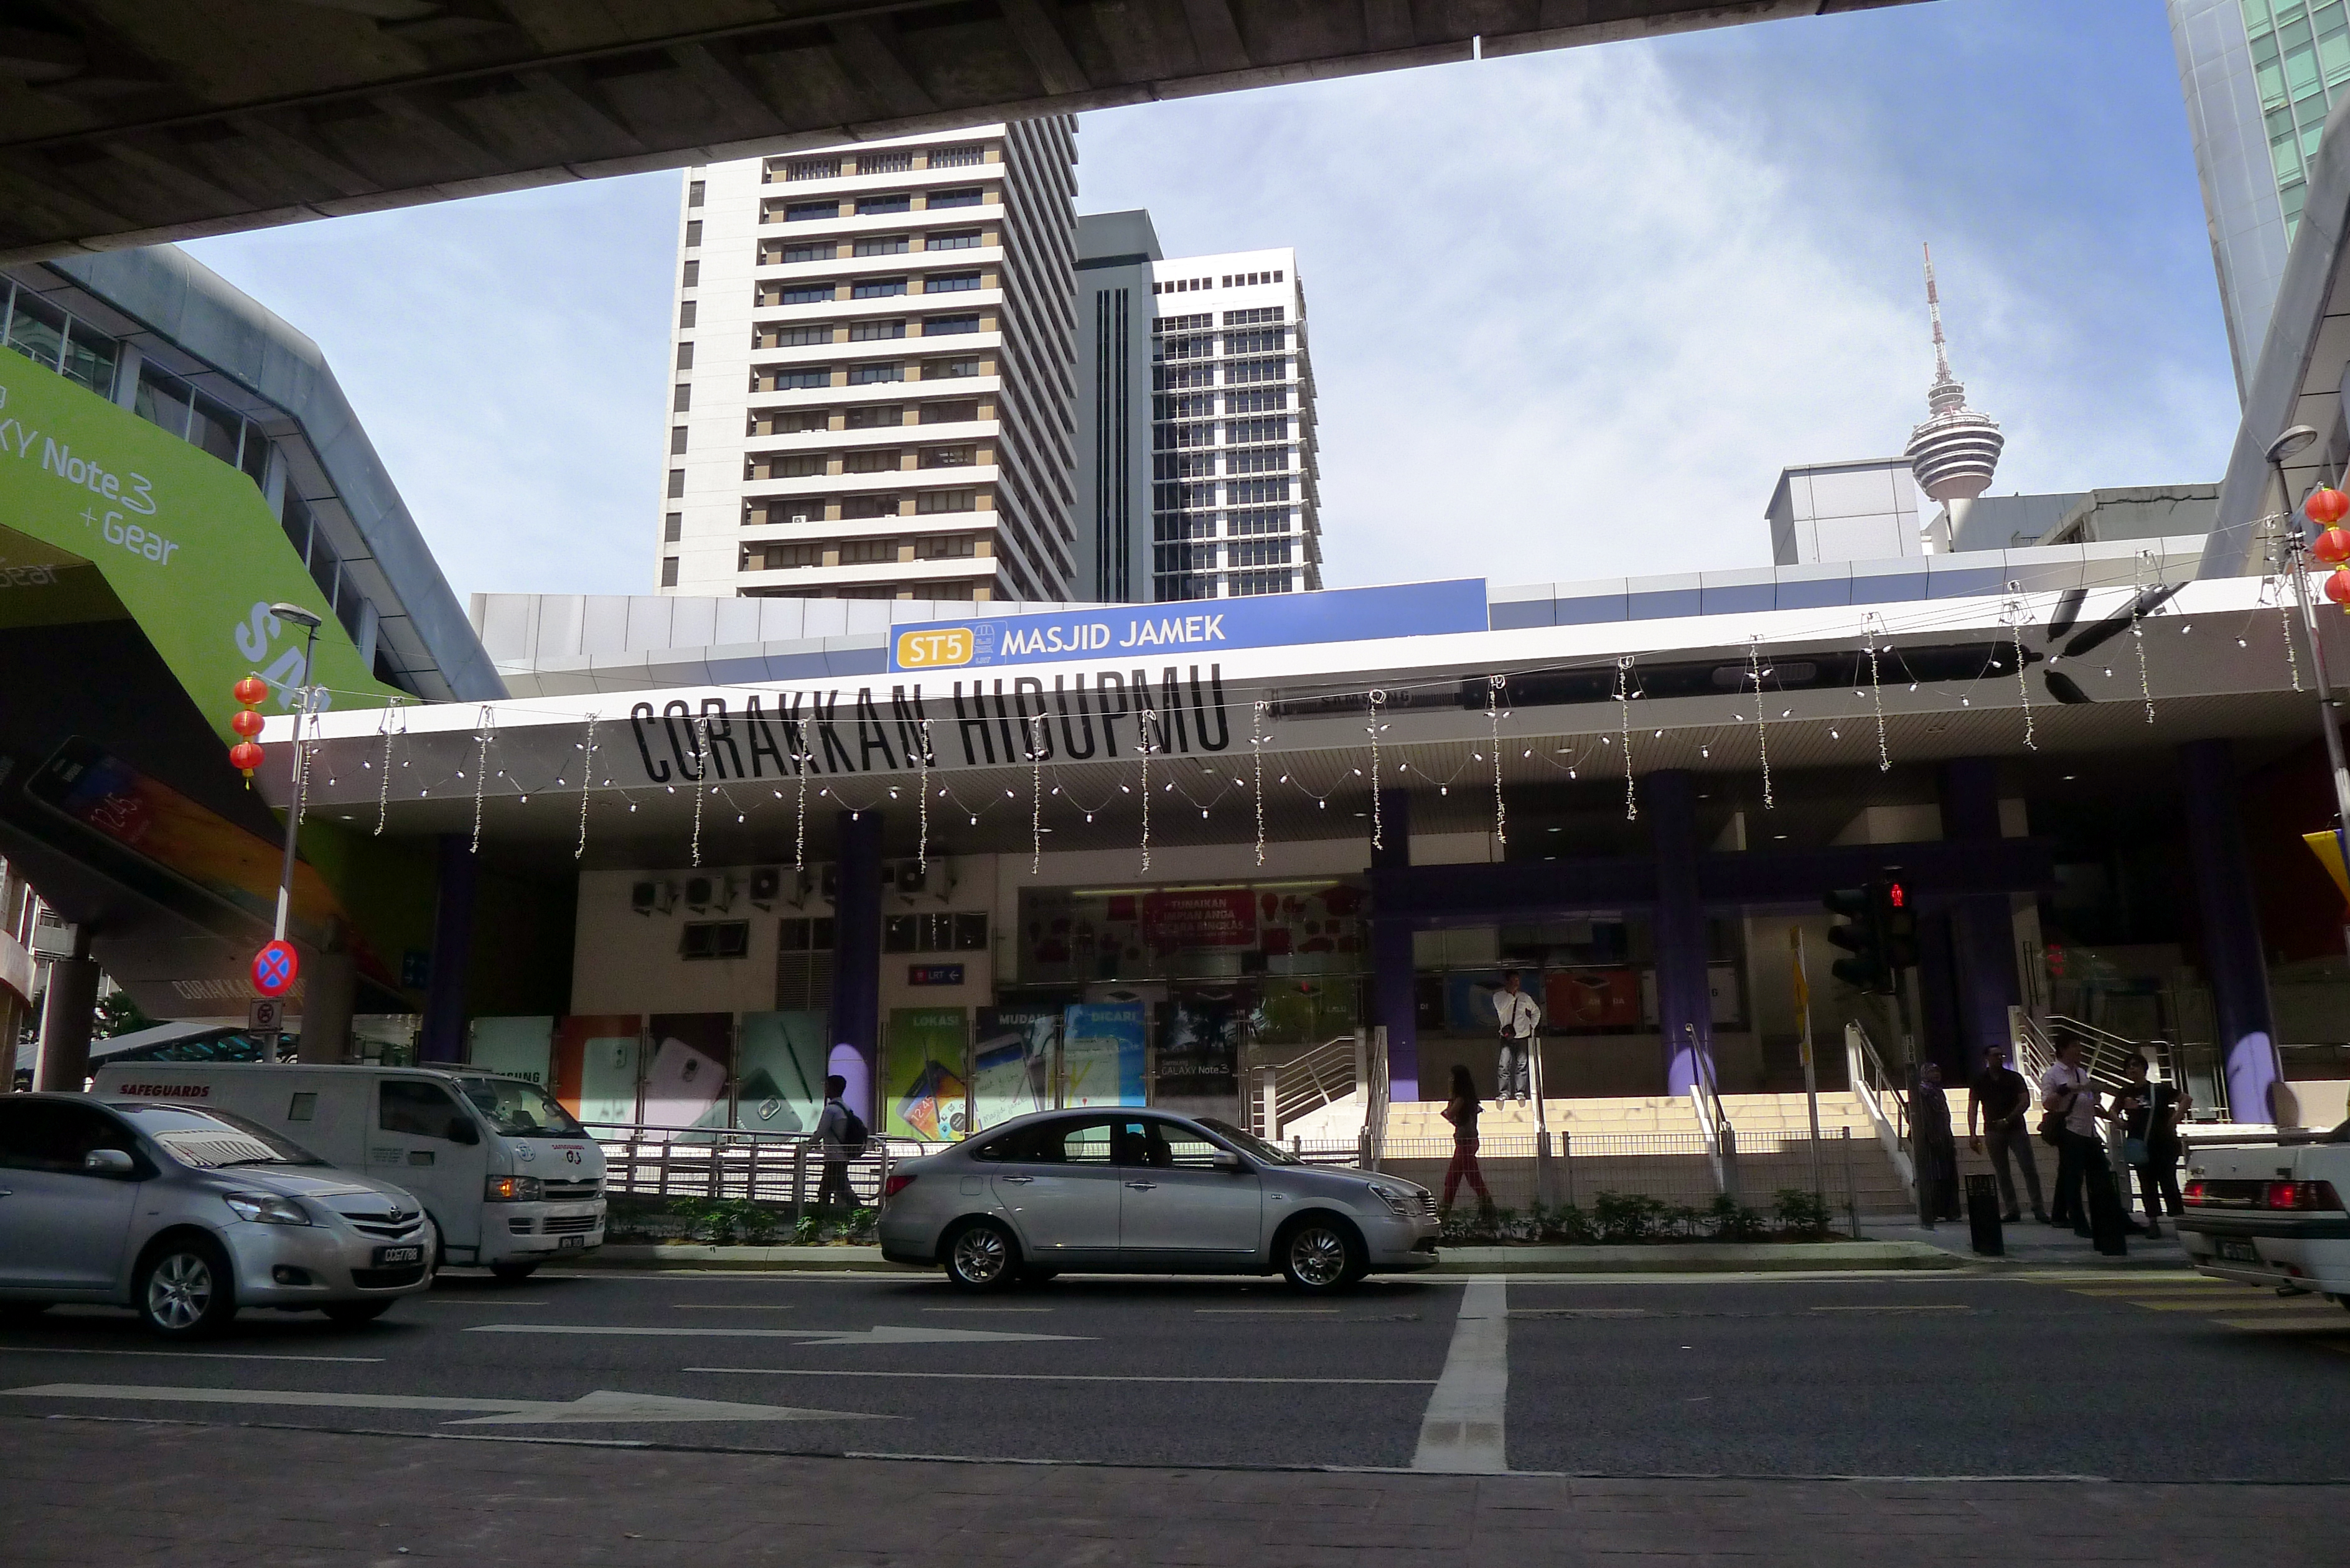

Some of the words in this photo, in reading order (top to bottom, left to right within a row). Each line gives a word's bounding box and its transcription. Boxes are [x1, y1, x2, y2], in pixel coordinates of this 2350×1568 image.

[42, 436, 120, 502] Note
[119, 471, 157, 516] 3
[103, 511, 179, 566] Gear
[909, 632, 963, 663] ST5
[1000, 623, 1111, 656] MASJID
[1118, 613, 1227, 648] JAMEK
[630, 683, 937, 783] CORAKKAN
[953, 663, 1230, 765] HIDUPMU
[1171, 898, 1227, 909] TUNAIKAN
[1204, 909, 1237, 920] ANDA
[928, 971, 944, 979] LRT
[912, 1015, 960, 1027] LOKASI
[1091, 1010, 1136, 1022] DICARI
[1161, 1066, 1197, 1075] GALAXY
[1198, 1065, 1219, 1075] Note
[1219, 1063, 1230, 1075] 3
[119, 1084, 210, 1098] SAFEGUARDS
